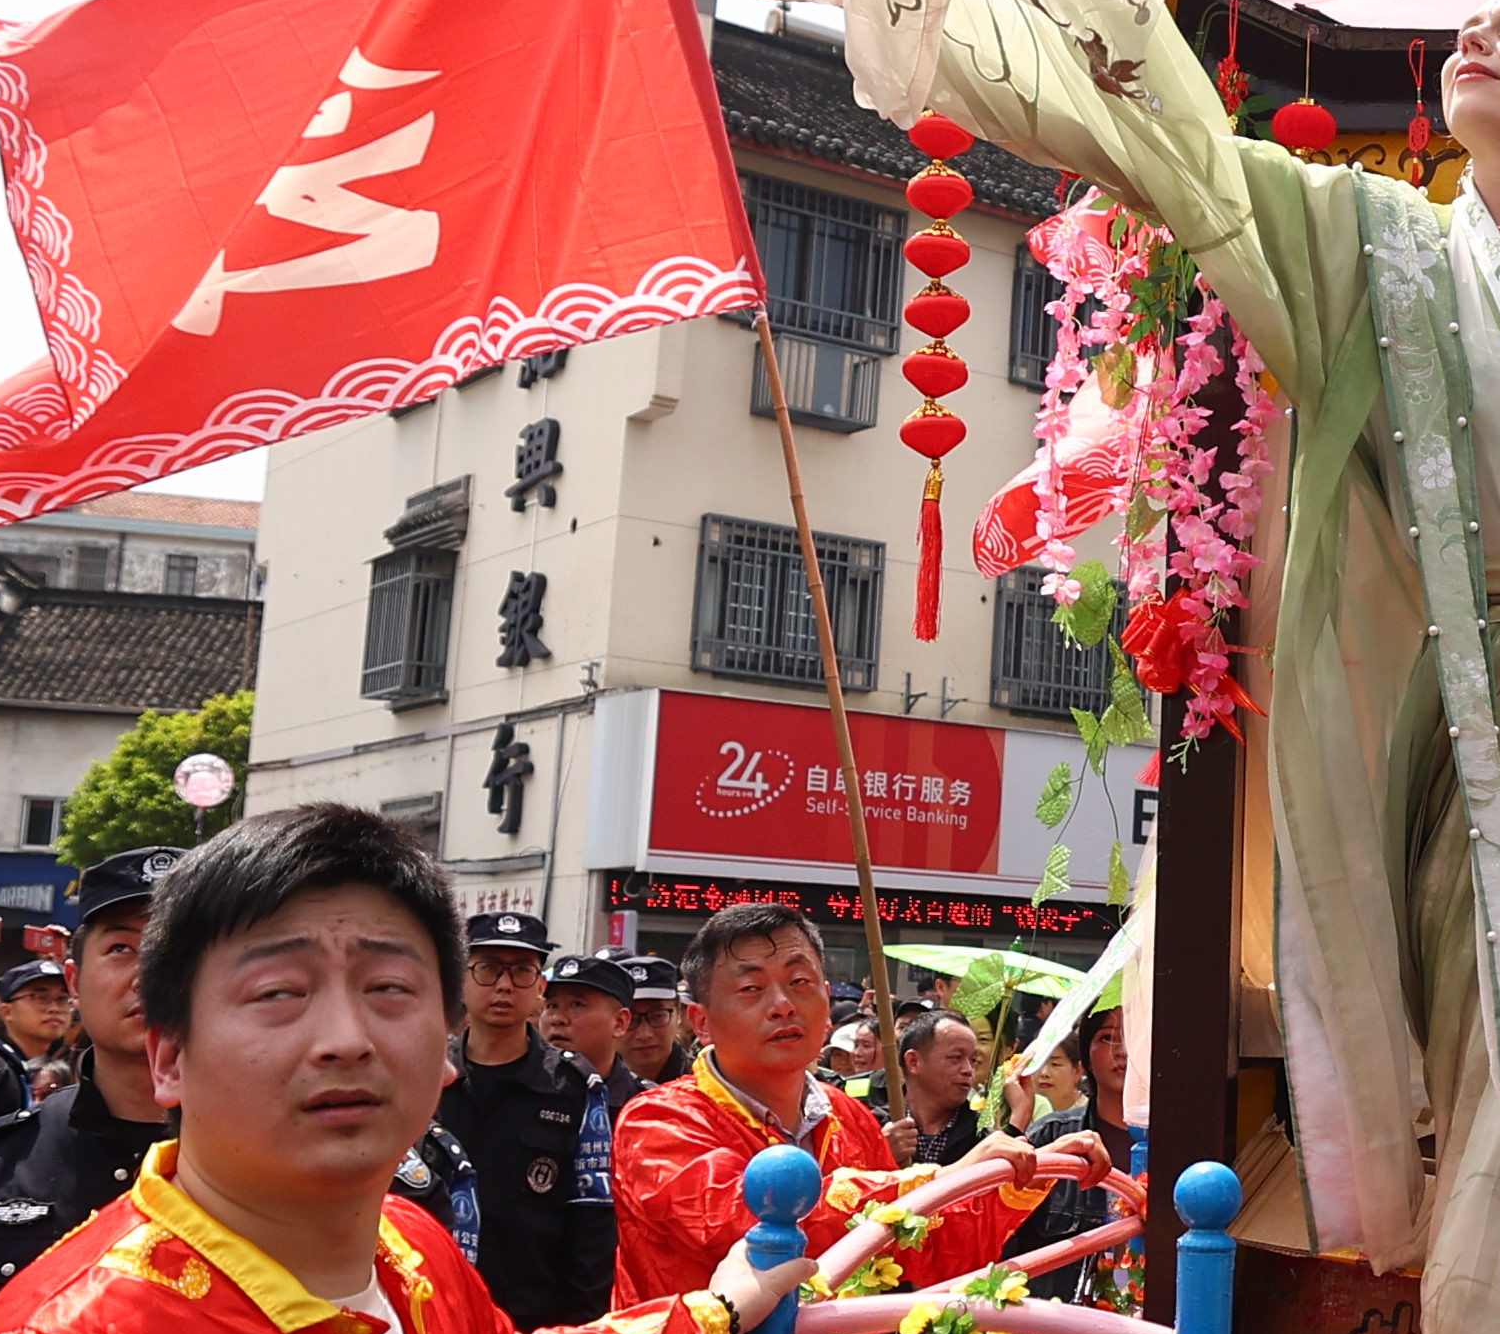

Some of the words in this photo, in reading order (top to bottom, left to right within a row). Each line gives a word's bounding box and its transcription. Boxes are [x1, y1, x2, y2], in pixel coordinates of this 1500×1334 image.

[716, 740, 769, 799] 24
[806, 797, 901, 821] Self-rvice
[906, 805, 968, 830] Banking
[577, 1171, 610, 1197] PT
